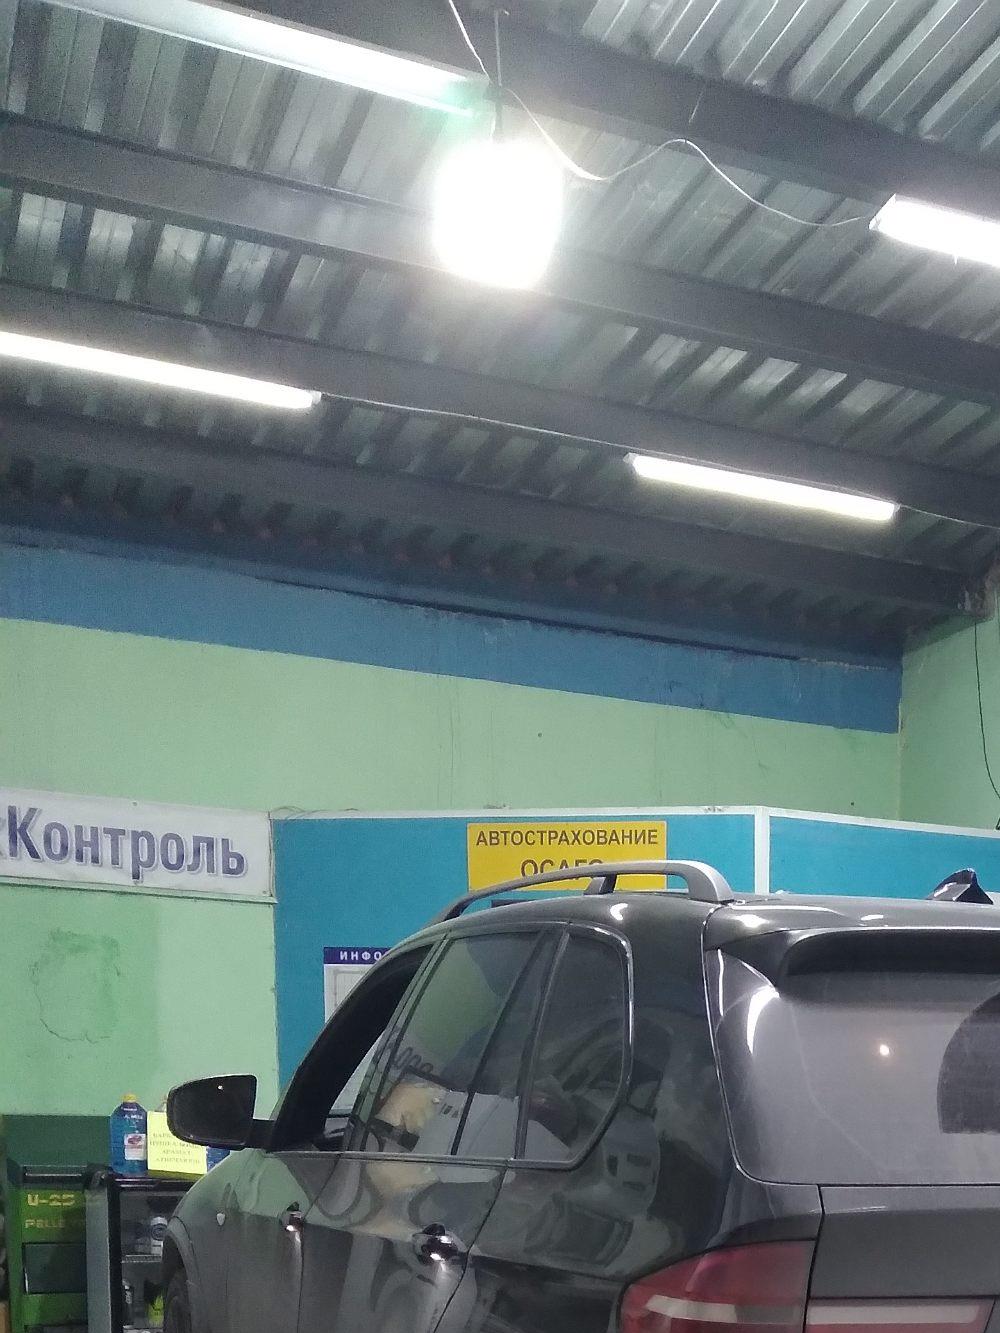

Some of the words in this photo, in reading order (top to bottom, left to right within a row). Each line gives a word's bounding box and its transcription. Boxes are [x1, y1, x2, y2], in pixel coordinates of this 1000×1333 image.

[0, 805, 247, 882] Контроль
[475, 828, 659, 847] АВТОСТРАХОВАНИЕ
[339, 950, 389, 961] ИНФО
